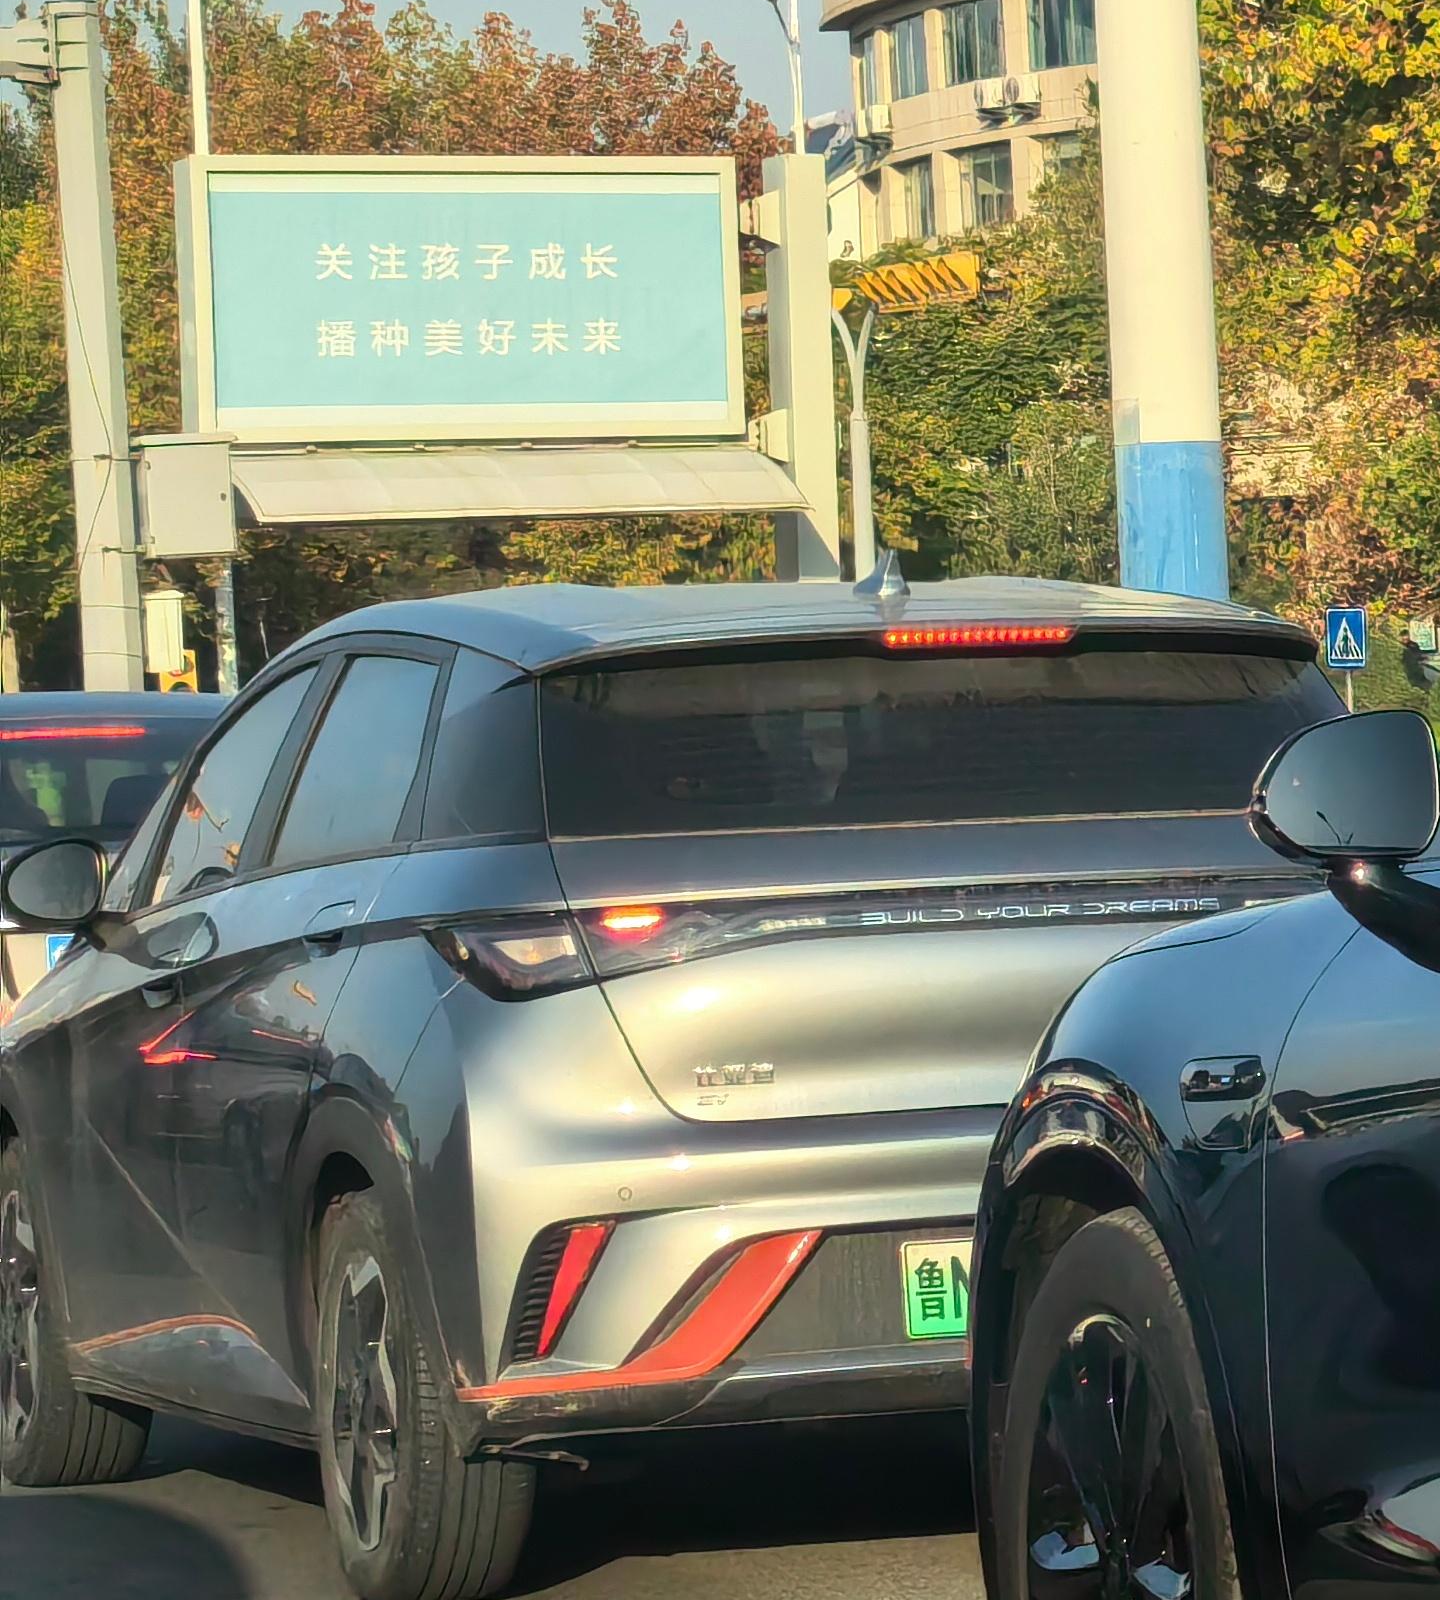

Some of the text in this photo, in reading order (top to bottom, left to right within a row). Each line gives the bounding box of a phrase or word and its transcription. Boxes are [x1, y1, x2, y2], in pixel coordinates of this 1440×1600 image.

[314, 242, 618, 281] 关注孩子成长
[316, 317, 622, 357] 播种美好未来
[861, 897, 1220, 925] BUILD YOUR DREAMS
